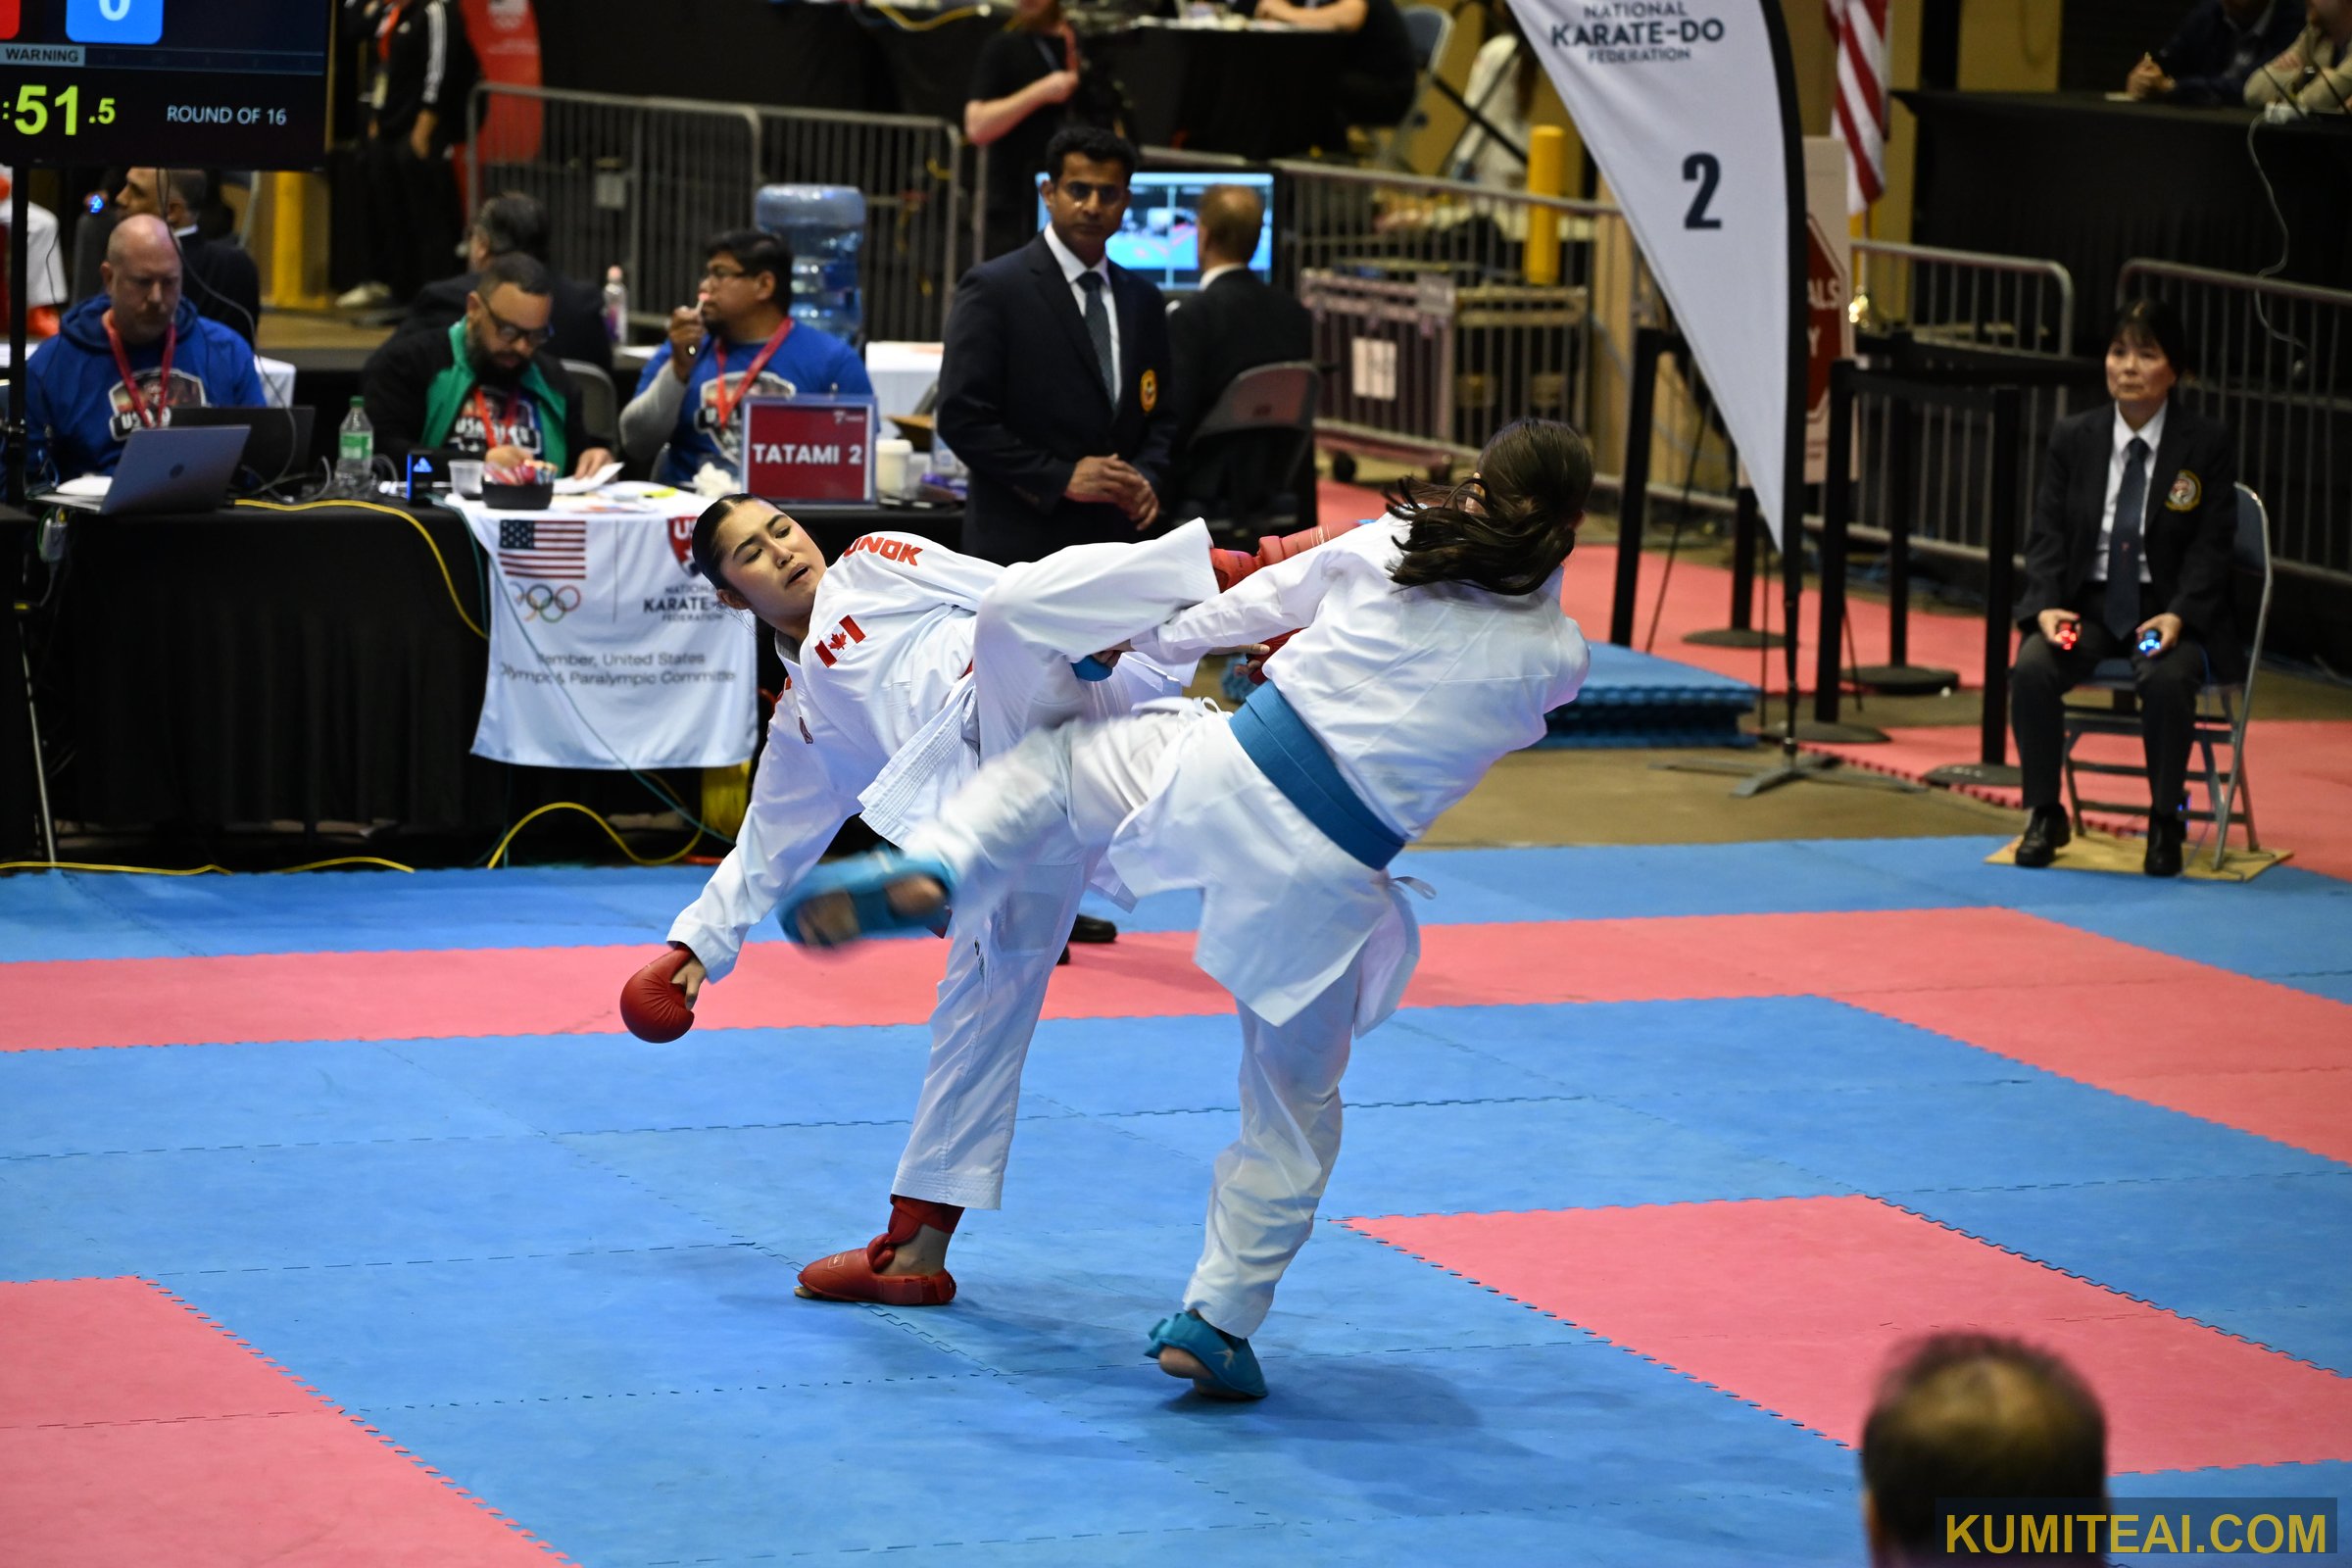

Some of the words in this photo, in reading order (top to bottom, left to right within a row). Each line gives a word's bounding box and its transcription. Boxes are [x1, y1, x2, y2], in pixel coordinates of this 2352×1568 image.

[1584, 0, 1688, 19] NATIONAL
[1551, 18, 1724, 47] KARATE-DO
[6, 47, 79, 63] WARNING
[1588, 47, 1690, 64] FEDERATION
[167, 104, 232, 123] ROUND
[237, 106, 261, 124] OF
[267, 108, 287, 125] 16
[1683, 151, 1722, 229] 2
[752, 444, 841, 465] TATAMI
[849, 444, 863, 465] 2
[604, 653, 653, 666] United
[658, 652, 706, 666] States
[569, 669, 658, 688] Paralympic
